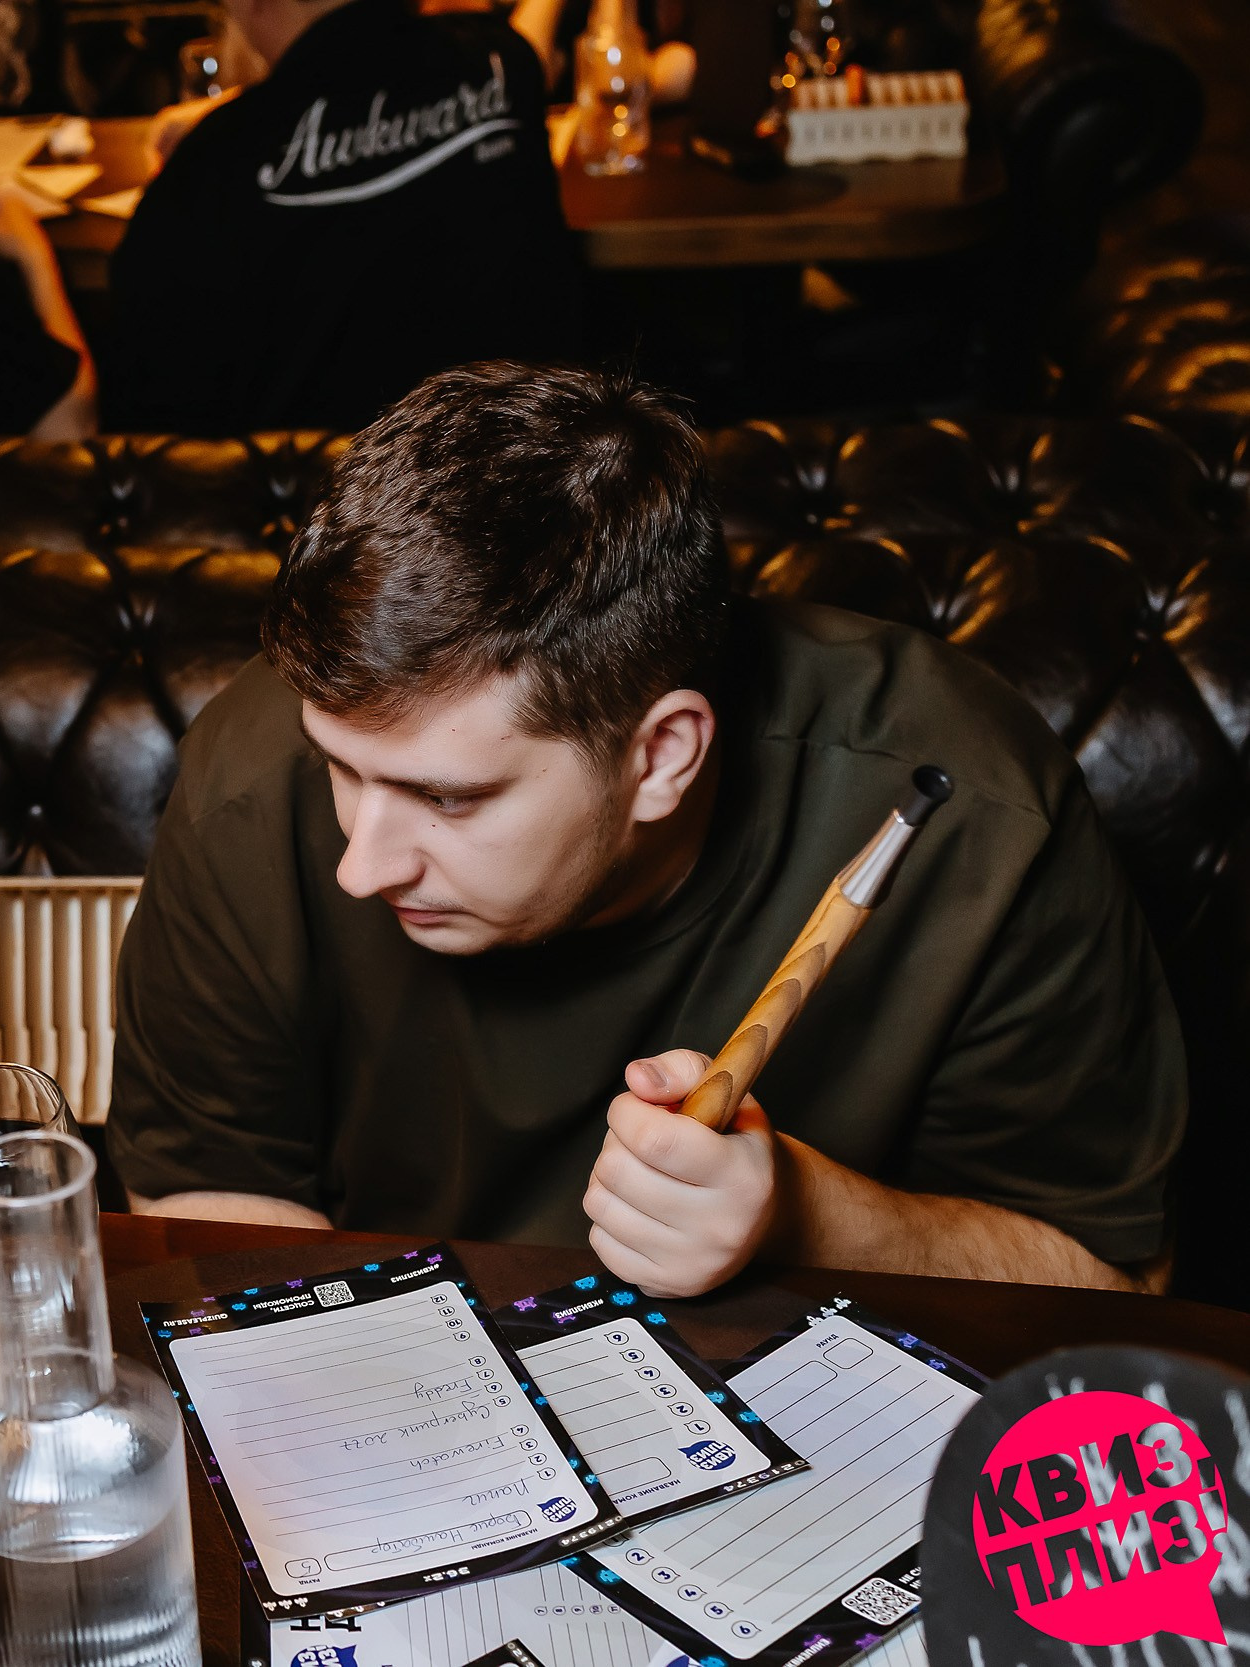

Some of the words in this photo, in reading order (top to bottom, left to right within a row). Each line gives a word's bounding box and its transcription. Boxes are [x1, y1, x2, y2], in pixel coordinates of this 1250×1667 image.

[258, 52, 510, 189] Awkward
[390, 1263, 440, 1283] #КВИЗПЛИЗ
[253, 1293, 311, 1310] ПРОМОКОДЫ
[270, 1300, 315, 1313] СОЦСЕТИ,
[555, 1298, 604, 1319] #КВИЗПЛИЗ
[163, 1313, 228, 1328] QUIZPLEASE.RU
[816, 1332, 839, 1349] РАУНД
[414, 1379, 472, 1401] Freddy
[398, 1400, 491, 1438] Cyberpunk
[410, 1436, 505, 1470] Firewatch
[723, 1458, 805, 1493] 0219374
[613, 1491, 638, 1505] КОМА
[638, 1478, 681, 1498] НАЗВАНИЕ
[505, 1528, 538, 1542] НАЗВАНИЕ
[559, 1515, 623, 1547] 0219374
[471, 1536, 504, 1550] КОМАНДЫ
